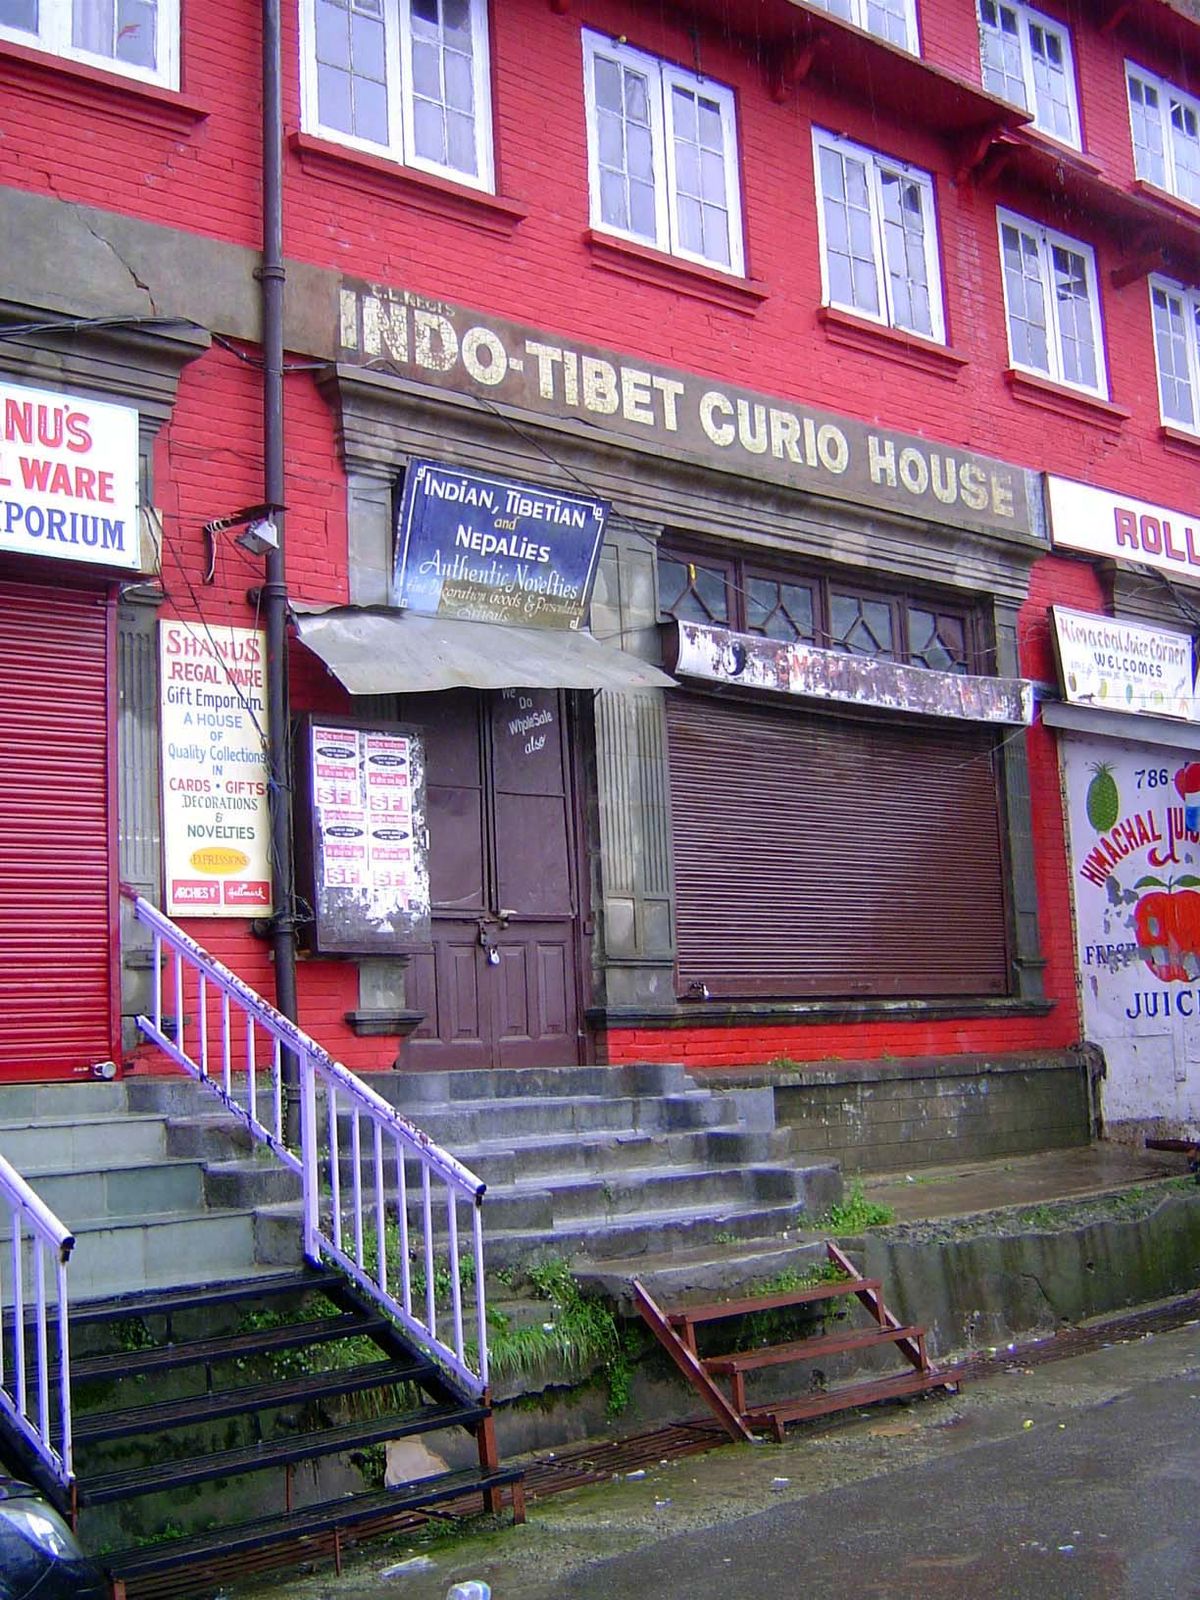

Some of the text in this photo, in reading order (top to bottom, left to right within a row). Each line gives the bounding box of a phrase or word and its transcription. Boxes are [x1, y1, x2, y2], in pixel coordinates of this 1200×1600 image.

[340, 287, 1015, 518] INDO-TIBET CURIO HOUSE
[0, 398, 92, 453] NU'S
[19, 456, 114, 503] WARE
[0, 501, 125, 551] PORIUM
[494, 516, 520, 531] and
[1114, 507, 1200, 566] ROLL
[420, 550, 578, 599] Authentic Novelties
[167, 629, 261, 662] SHANUS
[1060, 617, 1186, 666] Himachal Juice Corner
[168, 661, 263, 688] REGAL WARE
[1094, 652, 1163, 678] WELCOMES
[167, 686, 264, 712] Gift Emporium
[519, 696, 533, 709] Do
[184, 712, 243, 728] A HOUSE
[210, 731, 223, 742] OF
[524, 734, 546, 754] also
[168, 743, 266, 764] Quality Collections
[212, 765, 223, 776] IN
[1134, 768, 1168, 789] 786
[169, 778, 266, 795] CARDS GIFTS
[181, 794, 259, 811] DECORATIONS
[215, 812, 223, 823] &
[187, 824, 256, 840] NOVELTIES
[1080, 809, 1162, 888] HIMACHAL
[1126, 990, 1200, 1018] JUIC
